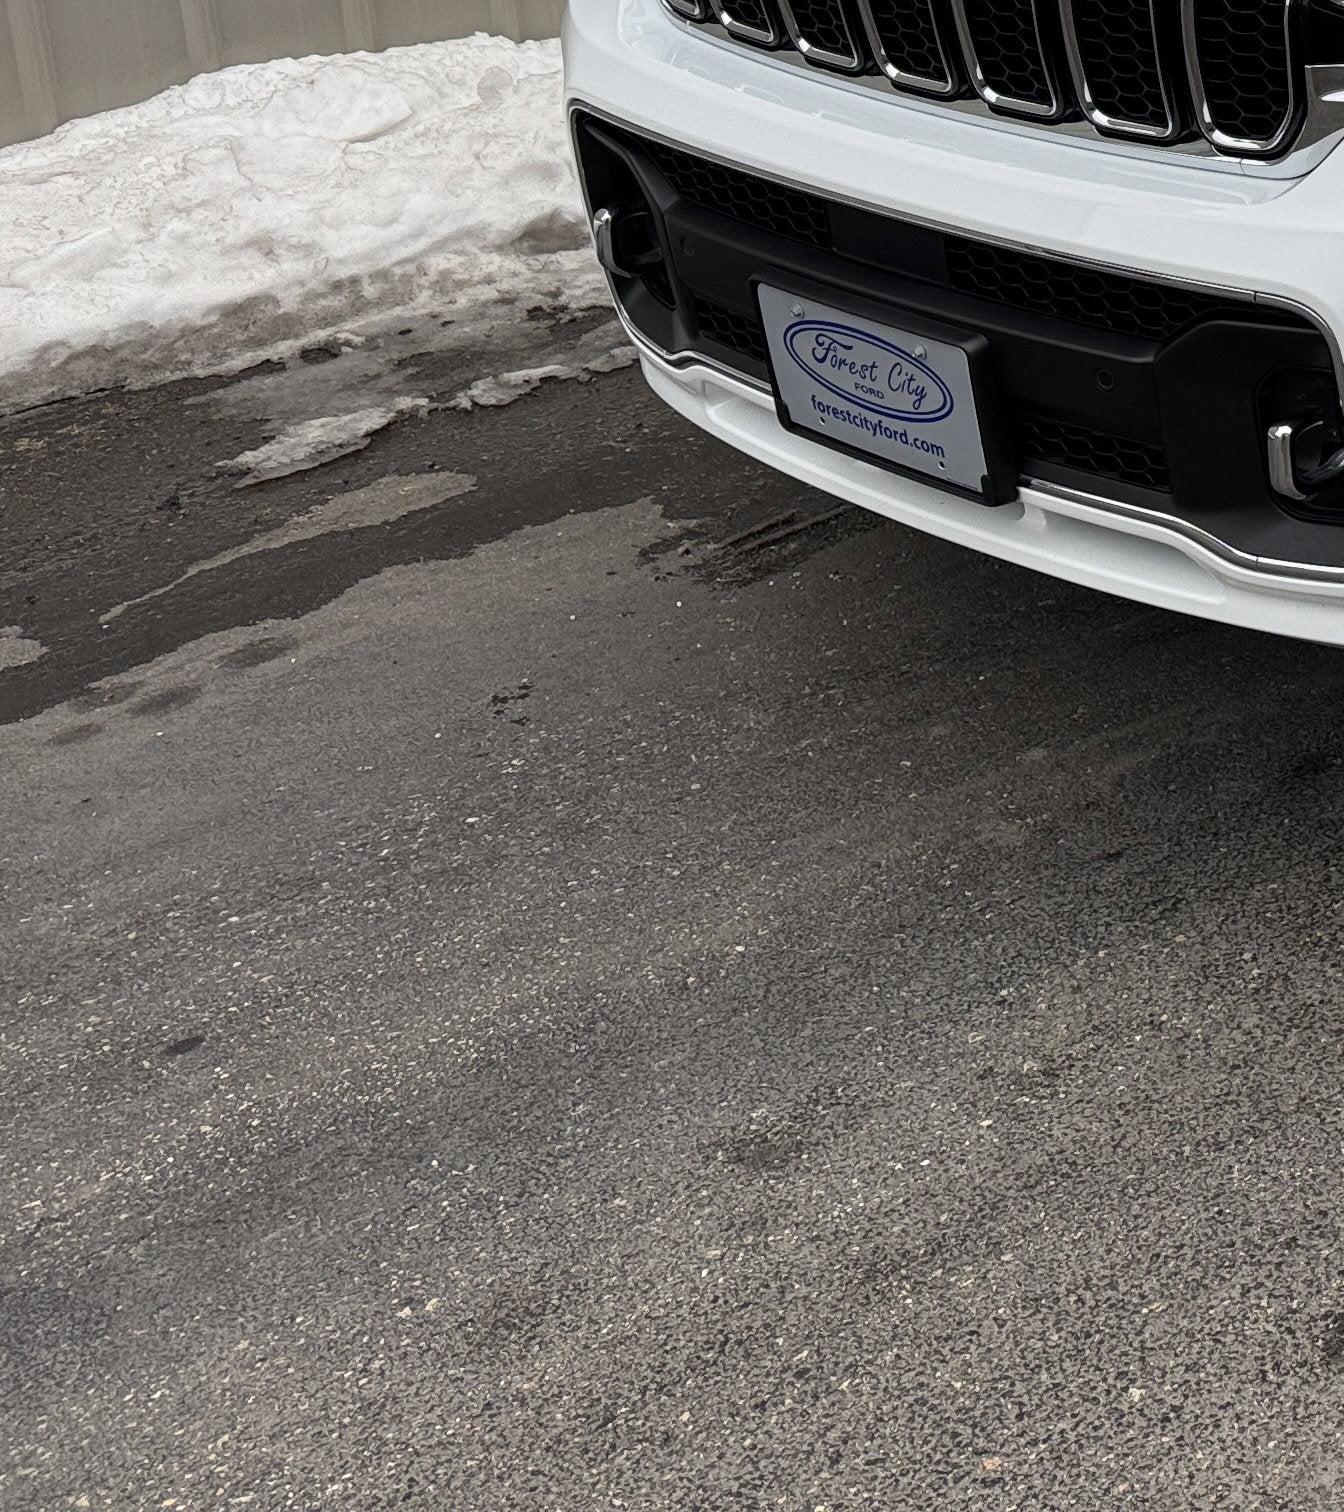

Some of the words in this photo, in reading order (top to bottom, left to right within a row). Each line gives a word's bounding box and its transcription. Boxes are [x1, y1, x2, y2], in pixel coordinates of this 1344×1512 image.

[811, 333, 878, 382] Forest
[887, 362, 927, 410] City
[854, 382, 885, 400] FORD
[811, 394, 945, 458] forestcityford.com
